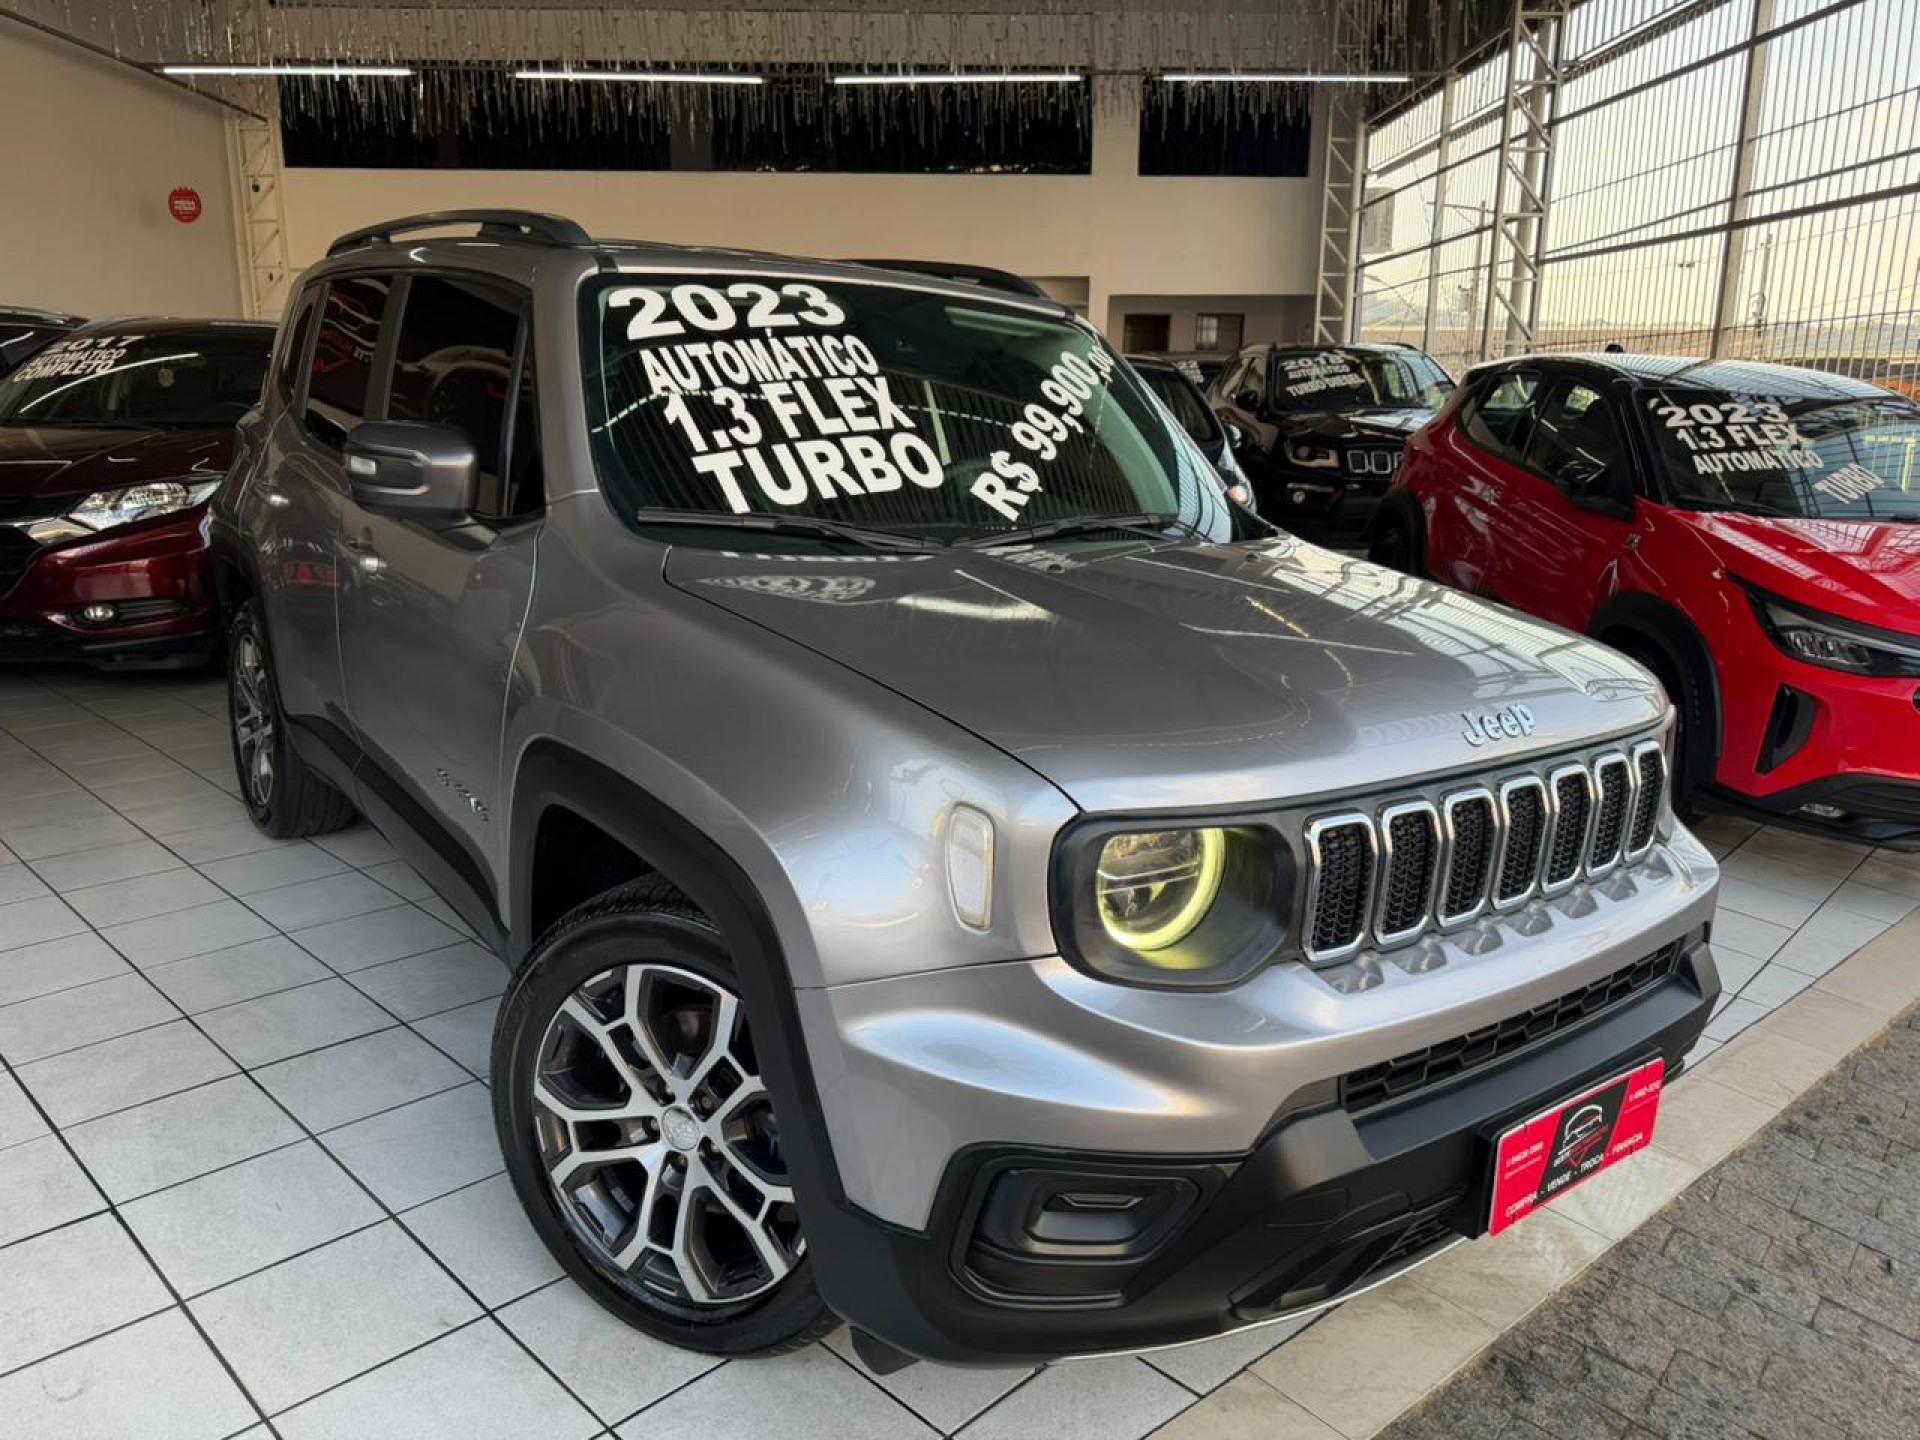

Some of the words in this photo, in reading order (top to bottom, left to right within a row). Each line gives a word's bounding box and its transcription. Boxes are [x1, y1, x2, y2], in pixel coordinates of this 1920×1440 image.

[608, 283, 846, 340] 2023
[13, 360, 114, 382] COMPLETO
[639, 327, 880, 396] AUTOMÁTICO
[663, 387, 762, 452] 1.3
[761, 376, 916, 439] FLEX
[1657, 403, 1788, 428] 2023
[1676, 426, 1726, 450] 1.3
[1725, 422, 1803, 448] FLEX
[691, 432, 944, 514] TURBO
[969, 450, 1043, 522] R$
[1812, 462, 1884, 505] TURBO
[1461, 704, 1536, 747] Jeep
